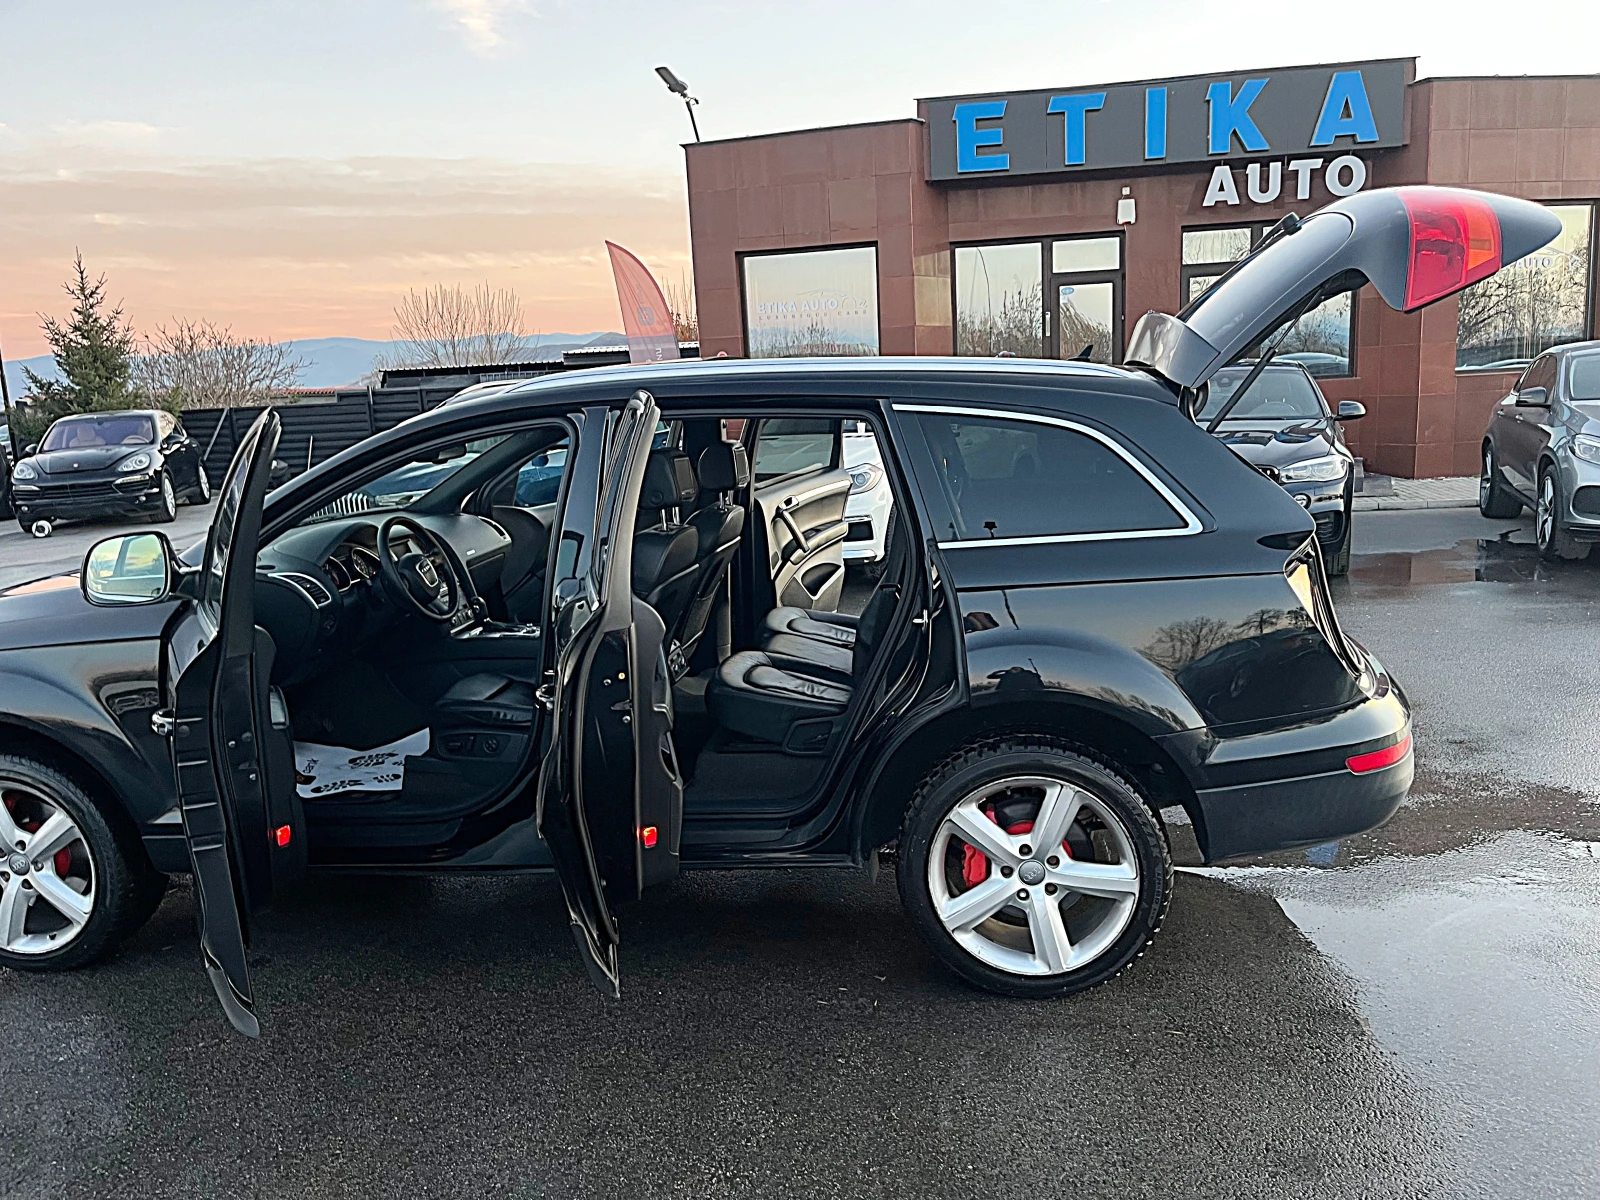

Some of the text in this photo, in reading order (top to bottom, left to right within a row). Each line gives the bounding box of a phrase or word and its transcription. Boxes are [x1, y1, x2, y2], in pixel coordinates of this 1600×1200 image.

[952, 70, 1379, 173] ETIKA
[1202, 155, 1366, 207] AUTO
[758, 299, 839, 314] ETIKA AUTO
